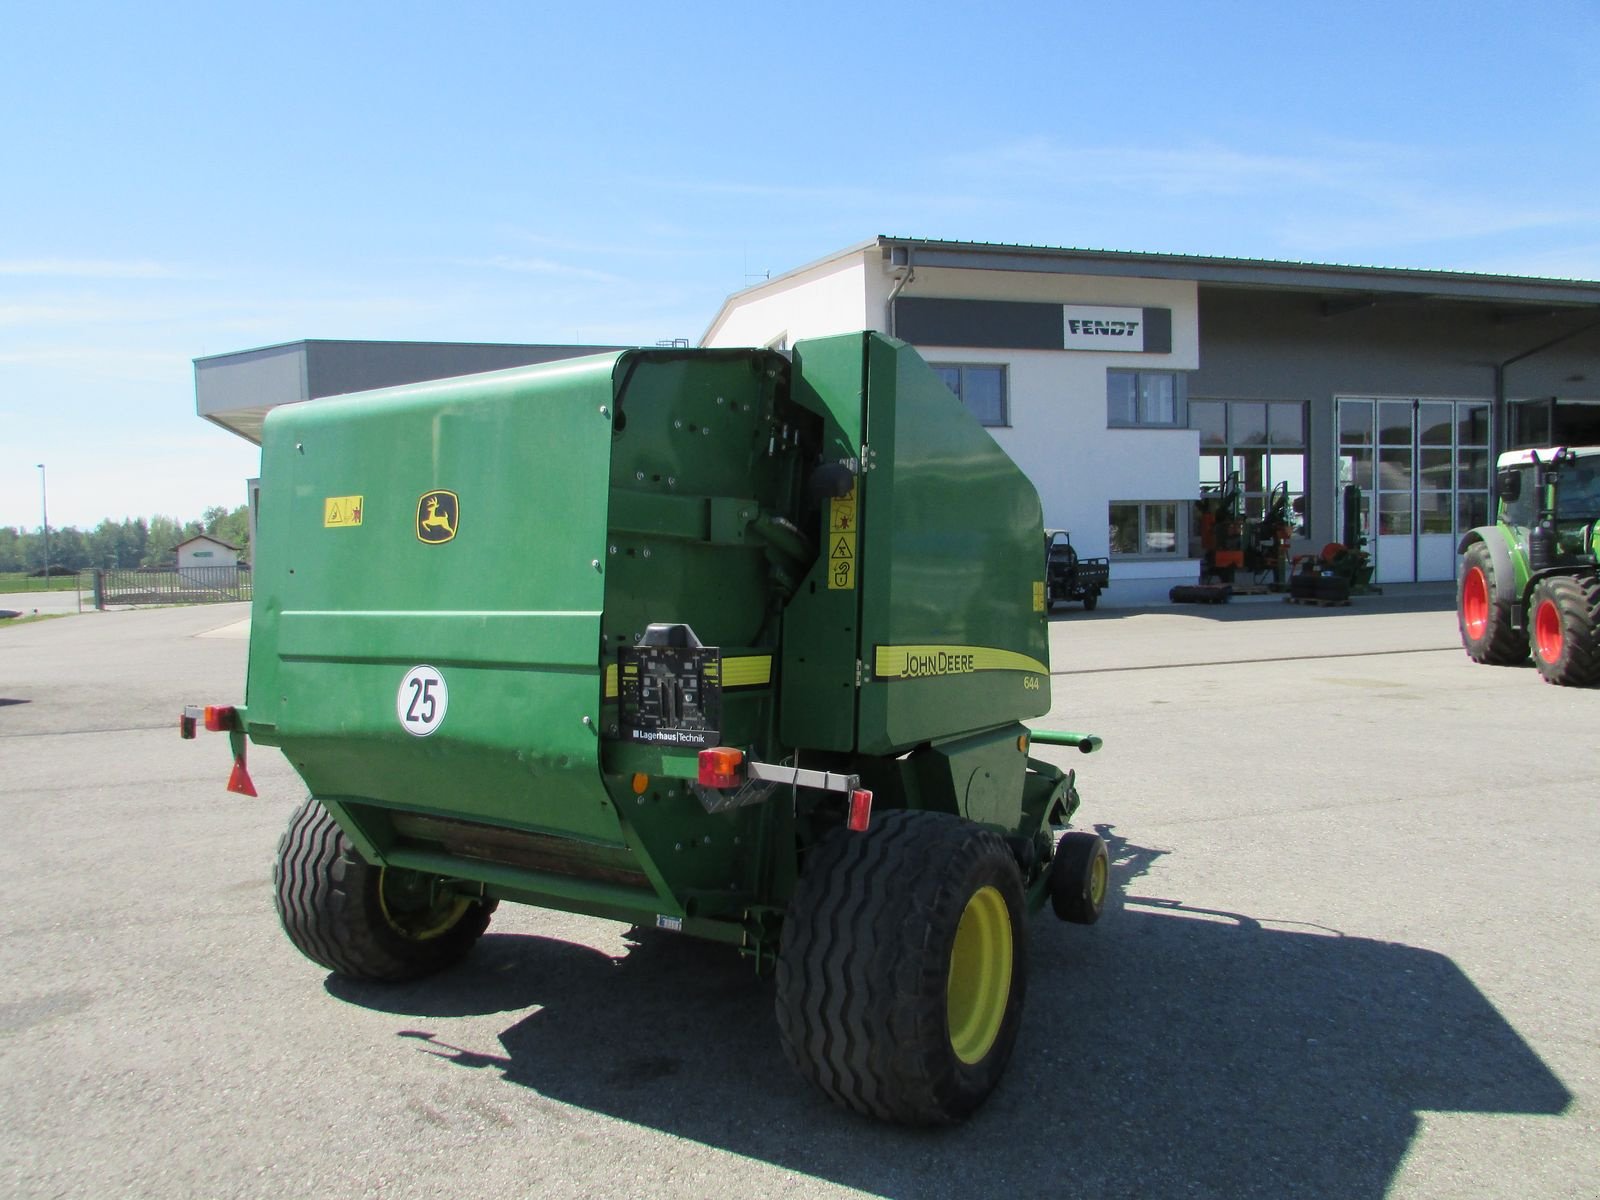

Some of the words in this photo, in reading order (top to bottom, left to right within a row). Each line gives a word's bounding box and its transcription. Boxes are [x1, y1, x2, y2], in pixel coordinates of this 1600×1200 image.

[1068, 319, 1139, 336] FENDT
[1023, 676, 1039, 690] 644
[406, 677, 438, 723] 25
